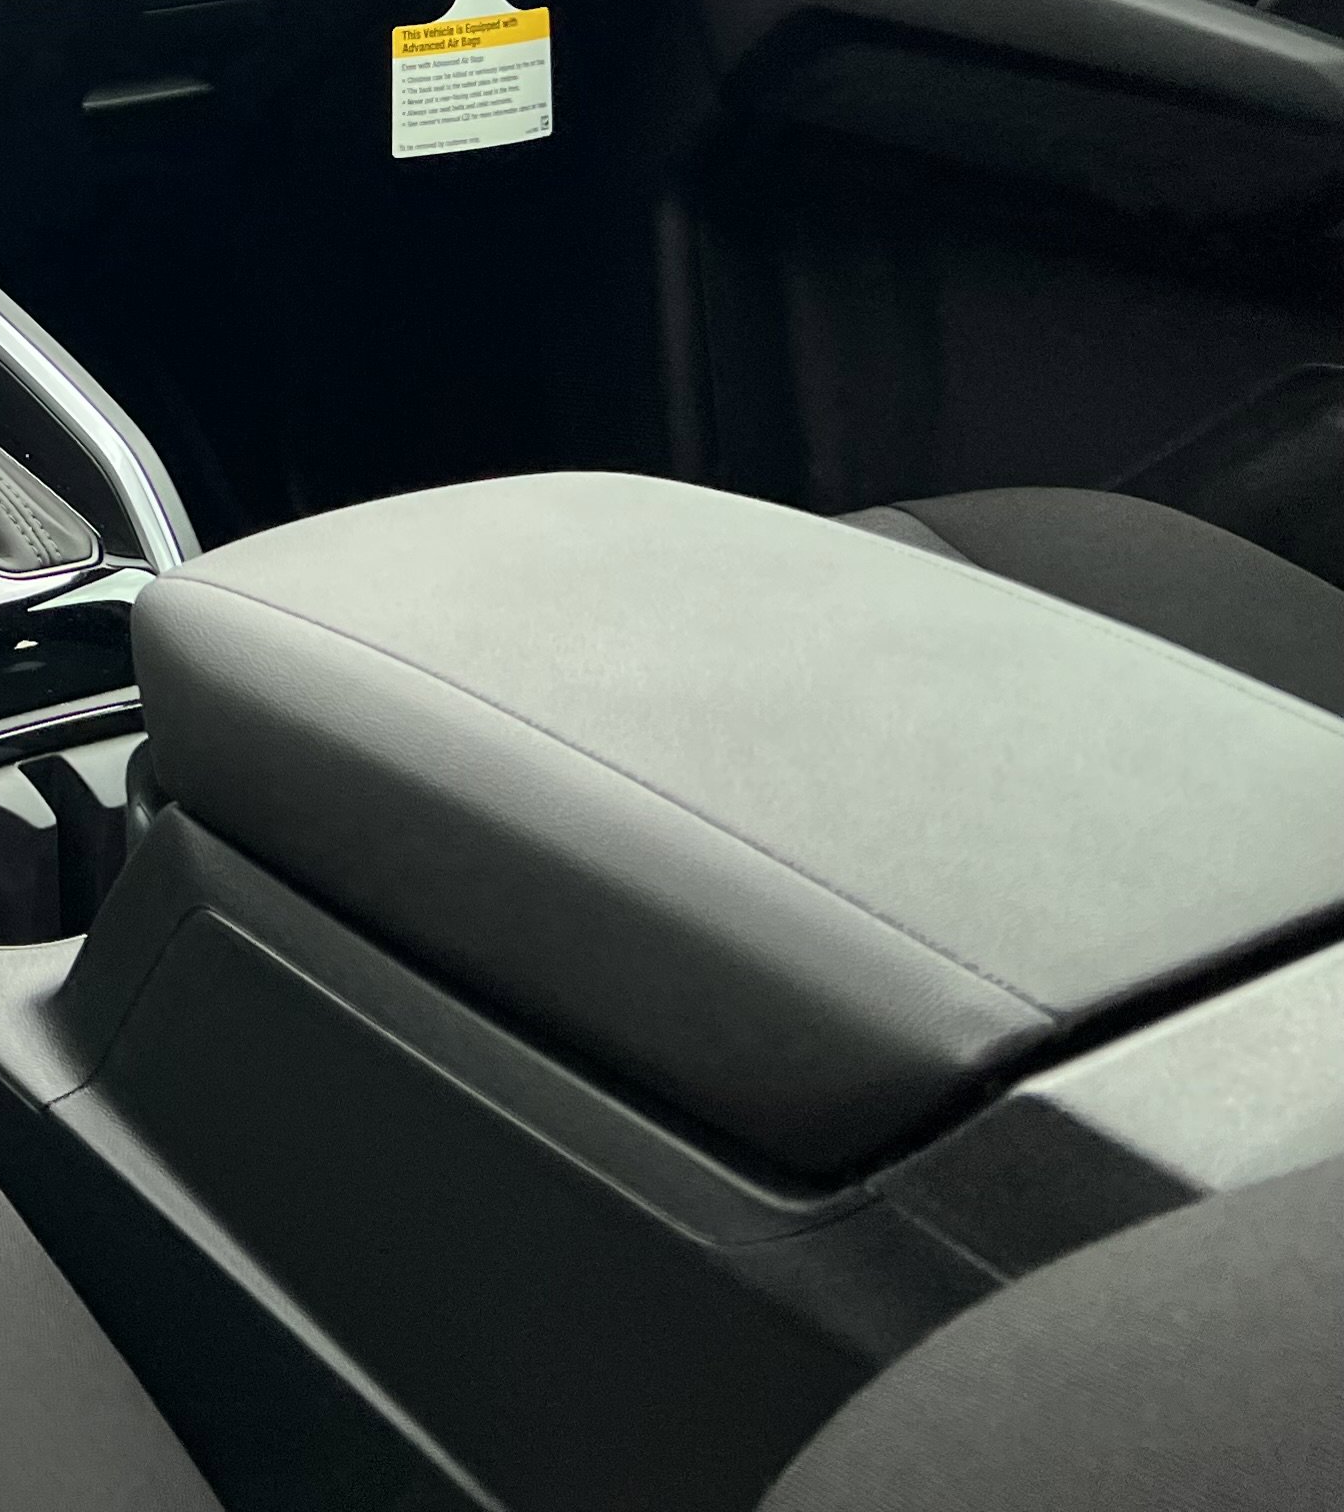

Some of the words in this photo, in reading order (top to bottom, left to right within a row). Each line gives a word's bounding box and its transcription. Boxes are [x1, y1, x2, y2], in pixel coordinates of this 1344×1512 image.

[402, 29, 421, 41] This
[423, 26, 454, 39] Vehicle
[402, 39, 445, 54] Advanced
[448, 38, 459, 48] Air
